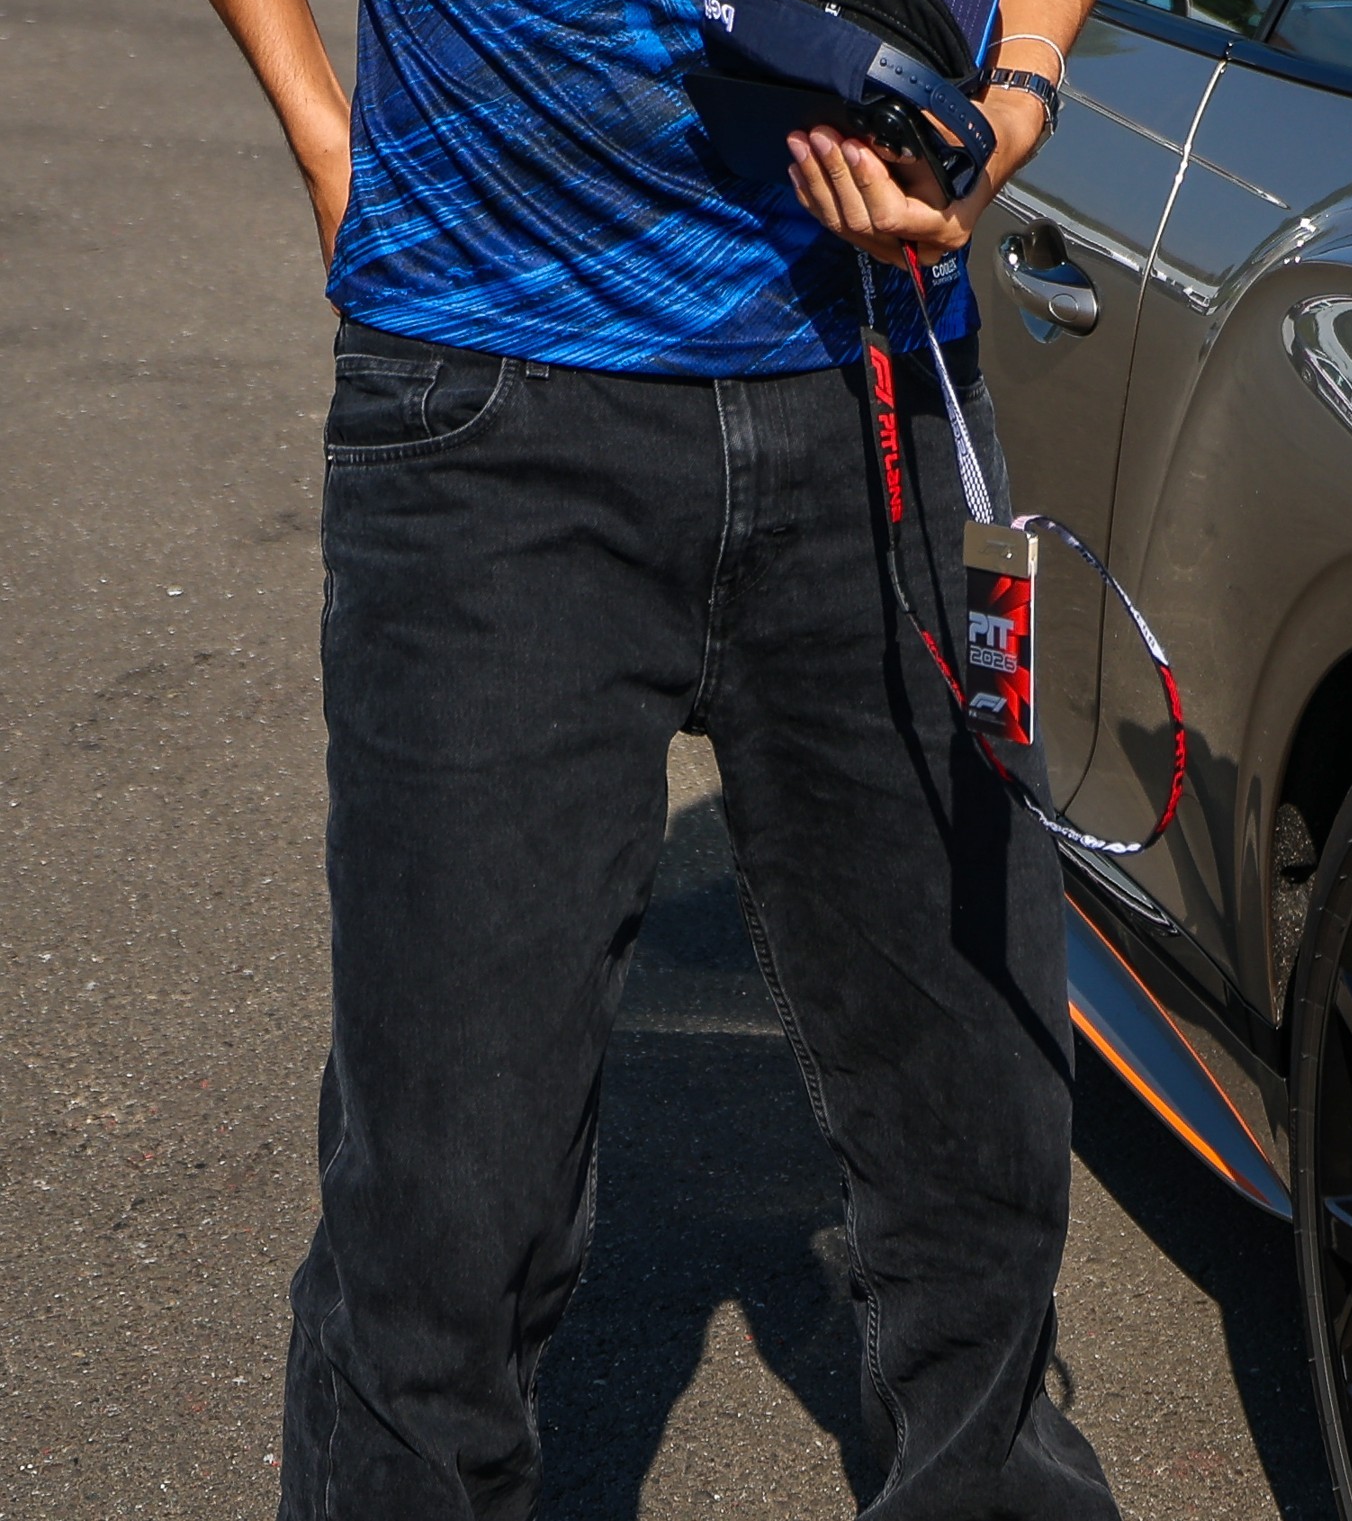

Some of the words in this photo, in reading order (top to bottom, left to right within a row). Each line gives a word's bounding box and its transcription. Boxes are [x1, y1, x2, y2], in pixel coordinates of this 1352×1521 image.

[869, 346, 895, 410] F1
[969, 611, 1015, 650] PIT
[970, 646, 1018, 673] 2026
[969, 692, 1008, 713] F1
